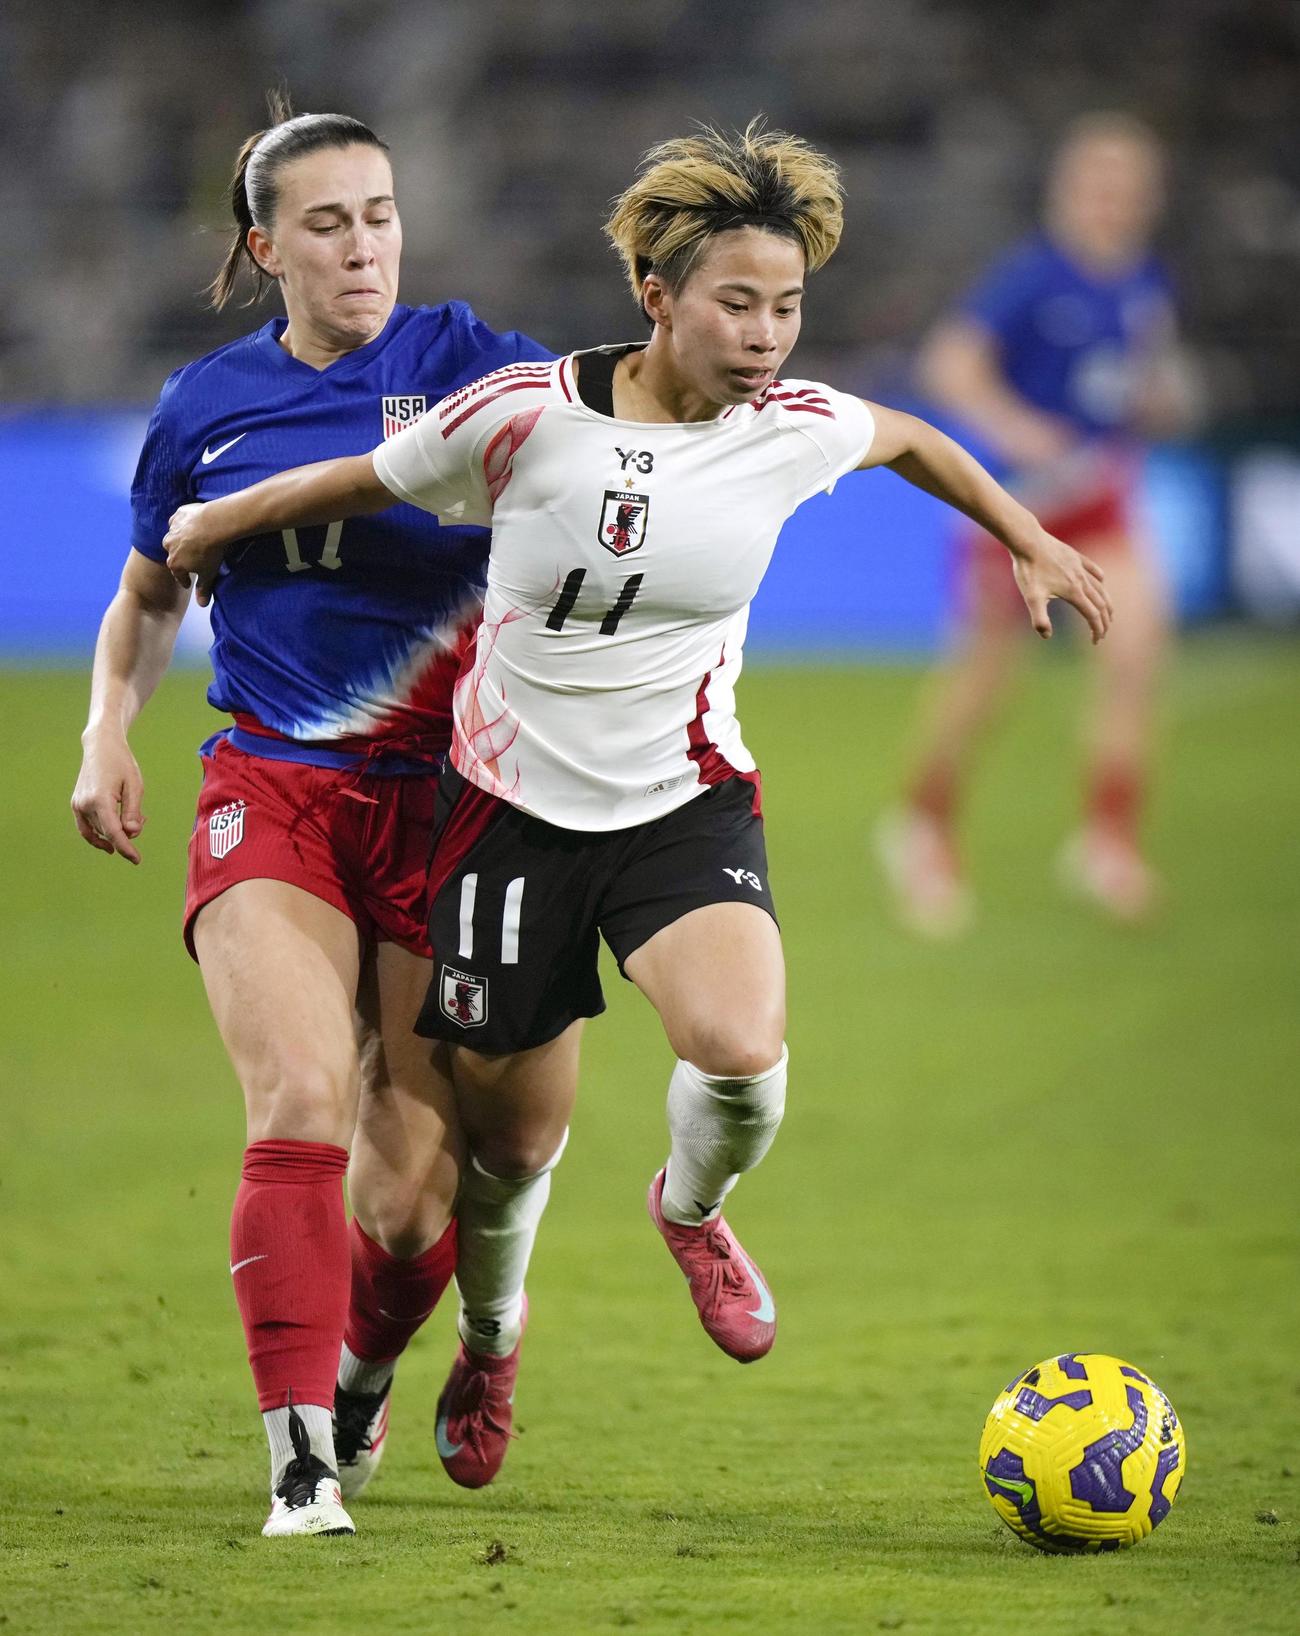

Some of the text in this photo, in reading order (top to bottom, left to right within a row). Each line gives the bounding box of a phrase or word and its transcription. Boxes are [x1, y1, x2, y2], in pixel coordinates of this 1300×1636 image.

[385, 398, 424, 421] USA
[614, 447, 654, 474] Y-3
[615, 493, 641, 502] JAPAN
[545, 567, 645, 636] 11
[211, 810, 242, 830] USA
[722, 868, 763, 892] Y-3
[458, 873, 525, 964] 11
[452, 971, 476, 984] JAPAN
